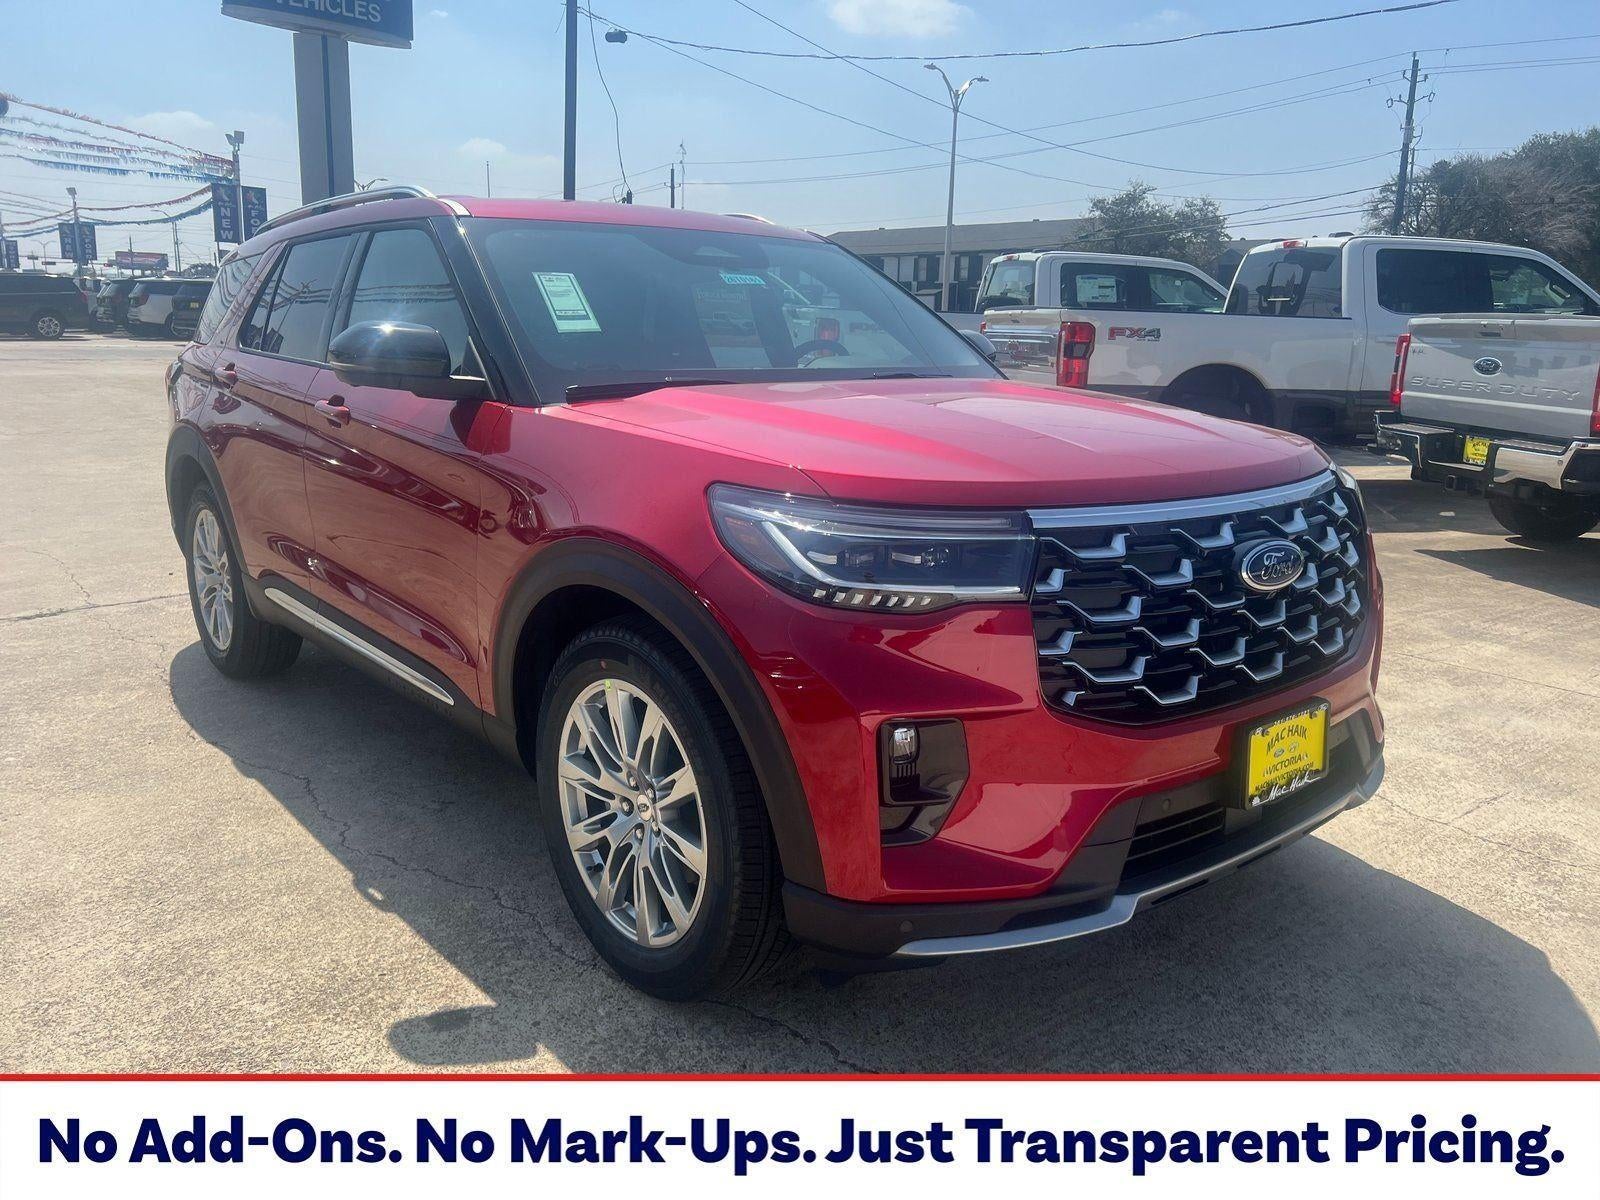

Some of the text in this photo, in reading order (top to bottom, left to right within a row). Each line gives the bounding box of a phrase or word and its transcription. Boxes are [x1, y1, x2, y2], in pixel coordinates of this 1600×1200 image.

[276, 0, 382, 23] HICLES
[220, 206, 233, 240] NEW
[1108, 326, 1161, 340] FX4
[1411, 376, 1580, 401] SUPER DUTY
[1260, 551, 1295, 580] Ford
[1266, 728, 1287, 754] MAC
[1287, 725, 1308, 740] HAIK
